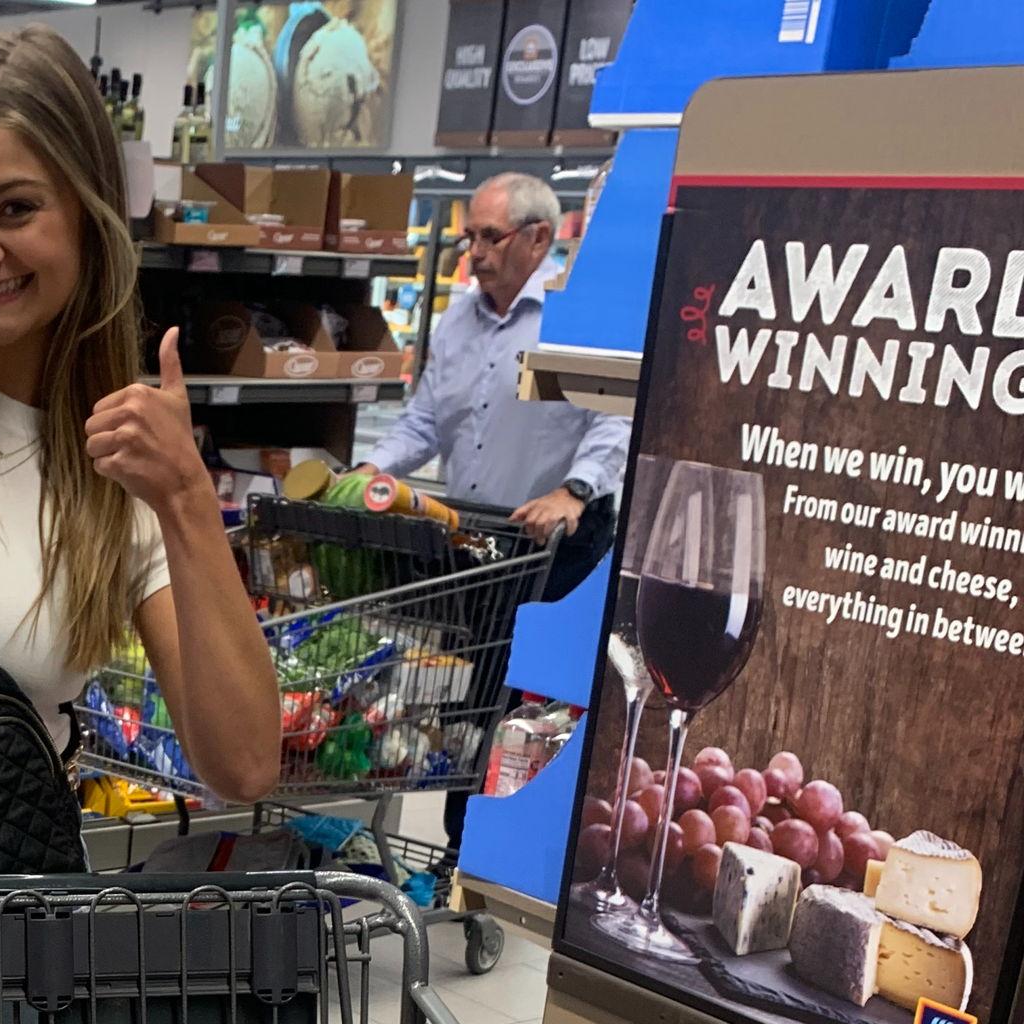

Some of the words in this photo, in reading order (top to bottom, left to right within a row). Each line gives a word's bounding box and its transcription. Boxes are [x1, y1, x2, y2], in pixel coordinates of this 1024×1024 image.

[444, 66, 492, 90] QUALITY
[578, 37, 611, 61] LOW
[741, 423, 819, 471] When
[824, 446, 865, 478] we
[869, 445, 932, 495] win,
[935, 461, 999, 503] you
[783, 484, 838, 522] From
[840, 502, 882, 528] our
[882, 510, 958, 542] award
[825, 543, 878, 577] wine
[880, 554, 928, 586] and
[928, 559, 1019, 610] cheese,
[783, 586, 904, 639] everything
[905, 603, 930, 636] in
[932, 607, 1024, 657] betwee
